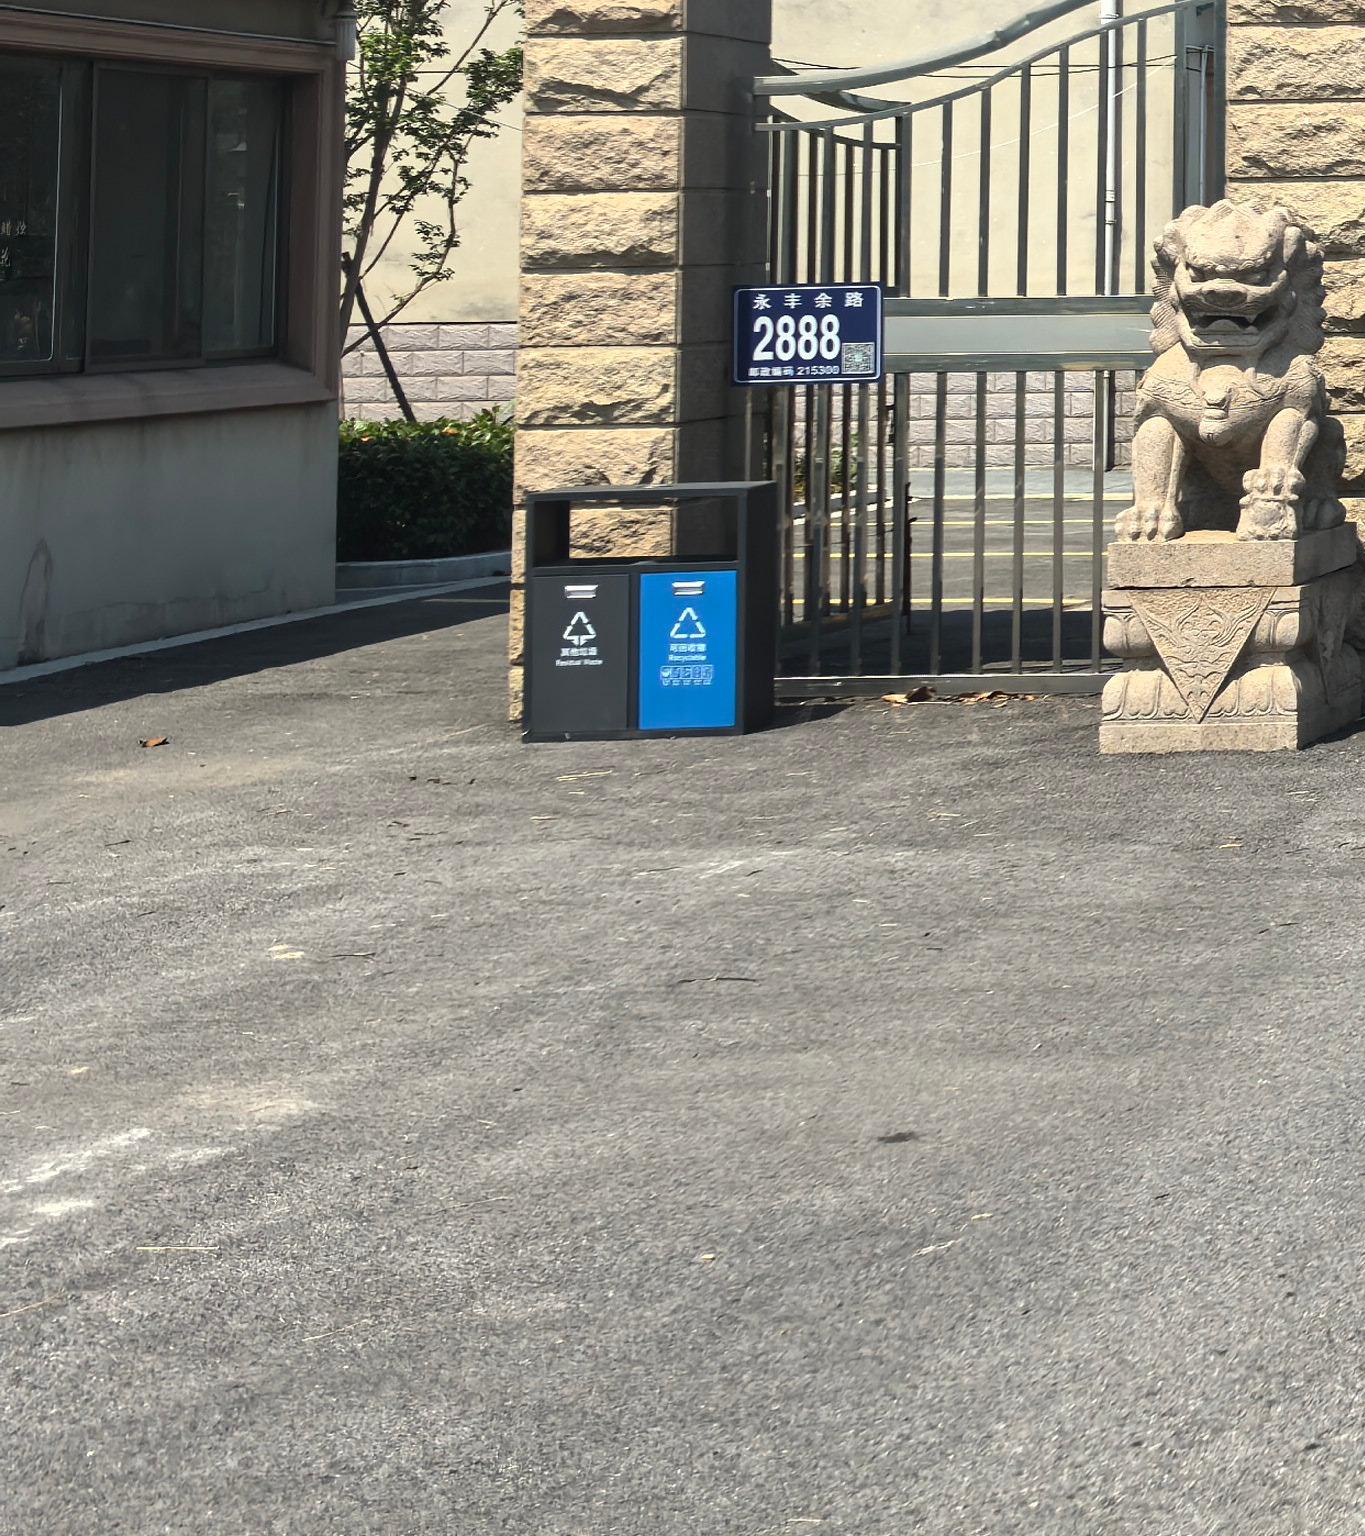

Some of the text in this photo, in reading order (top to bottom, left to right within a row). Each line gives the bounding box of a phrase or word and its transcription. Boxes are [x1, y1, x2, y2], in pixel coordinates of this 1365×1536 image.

[752, 292, 864, 310] 永丰余路
[752, 314, 841, 361] 2888
[797, 365, 840, 375] 215300
